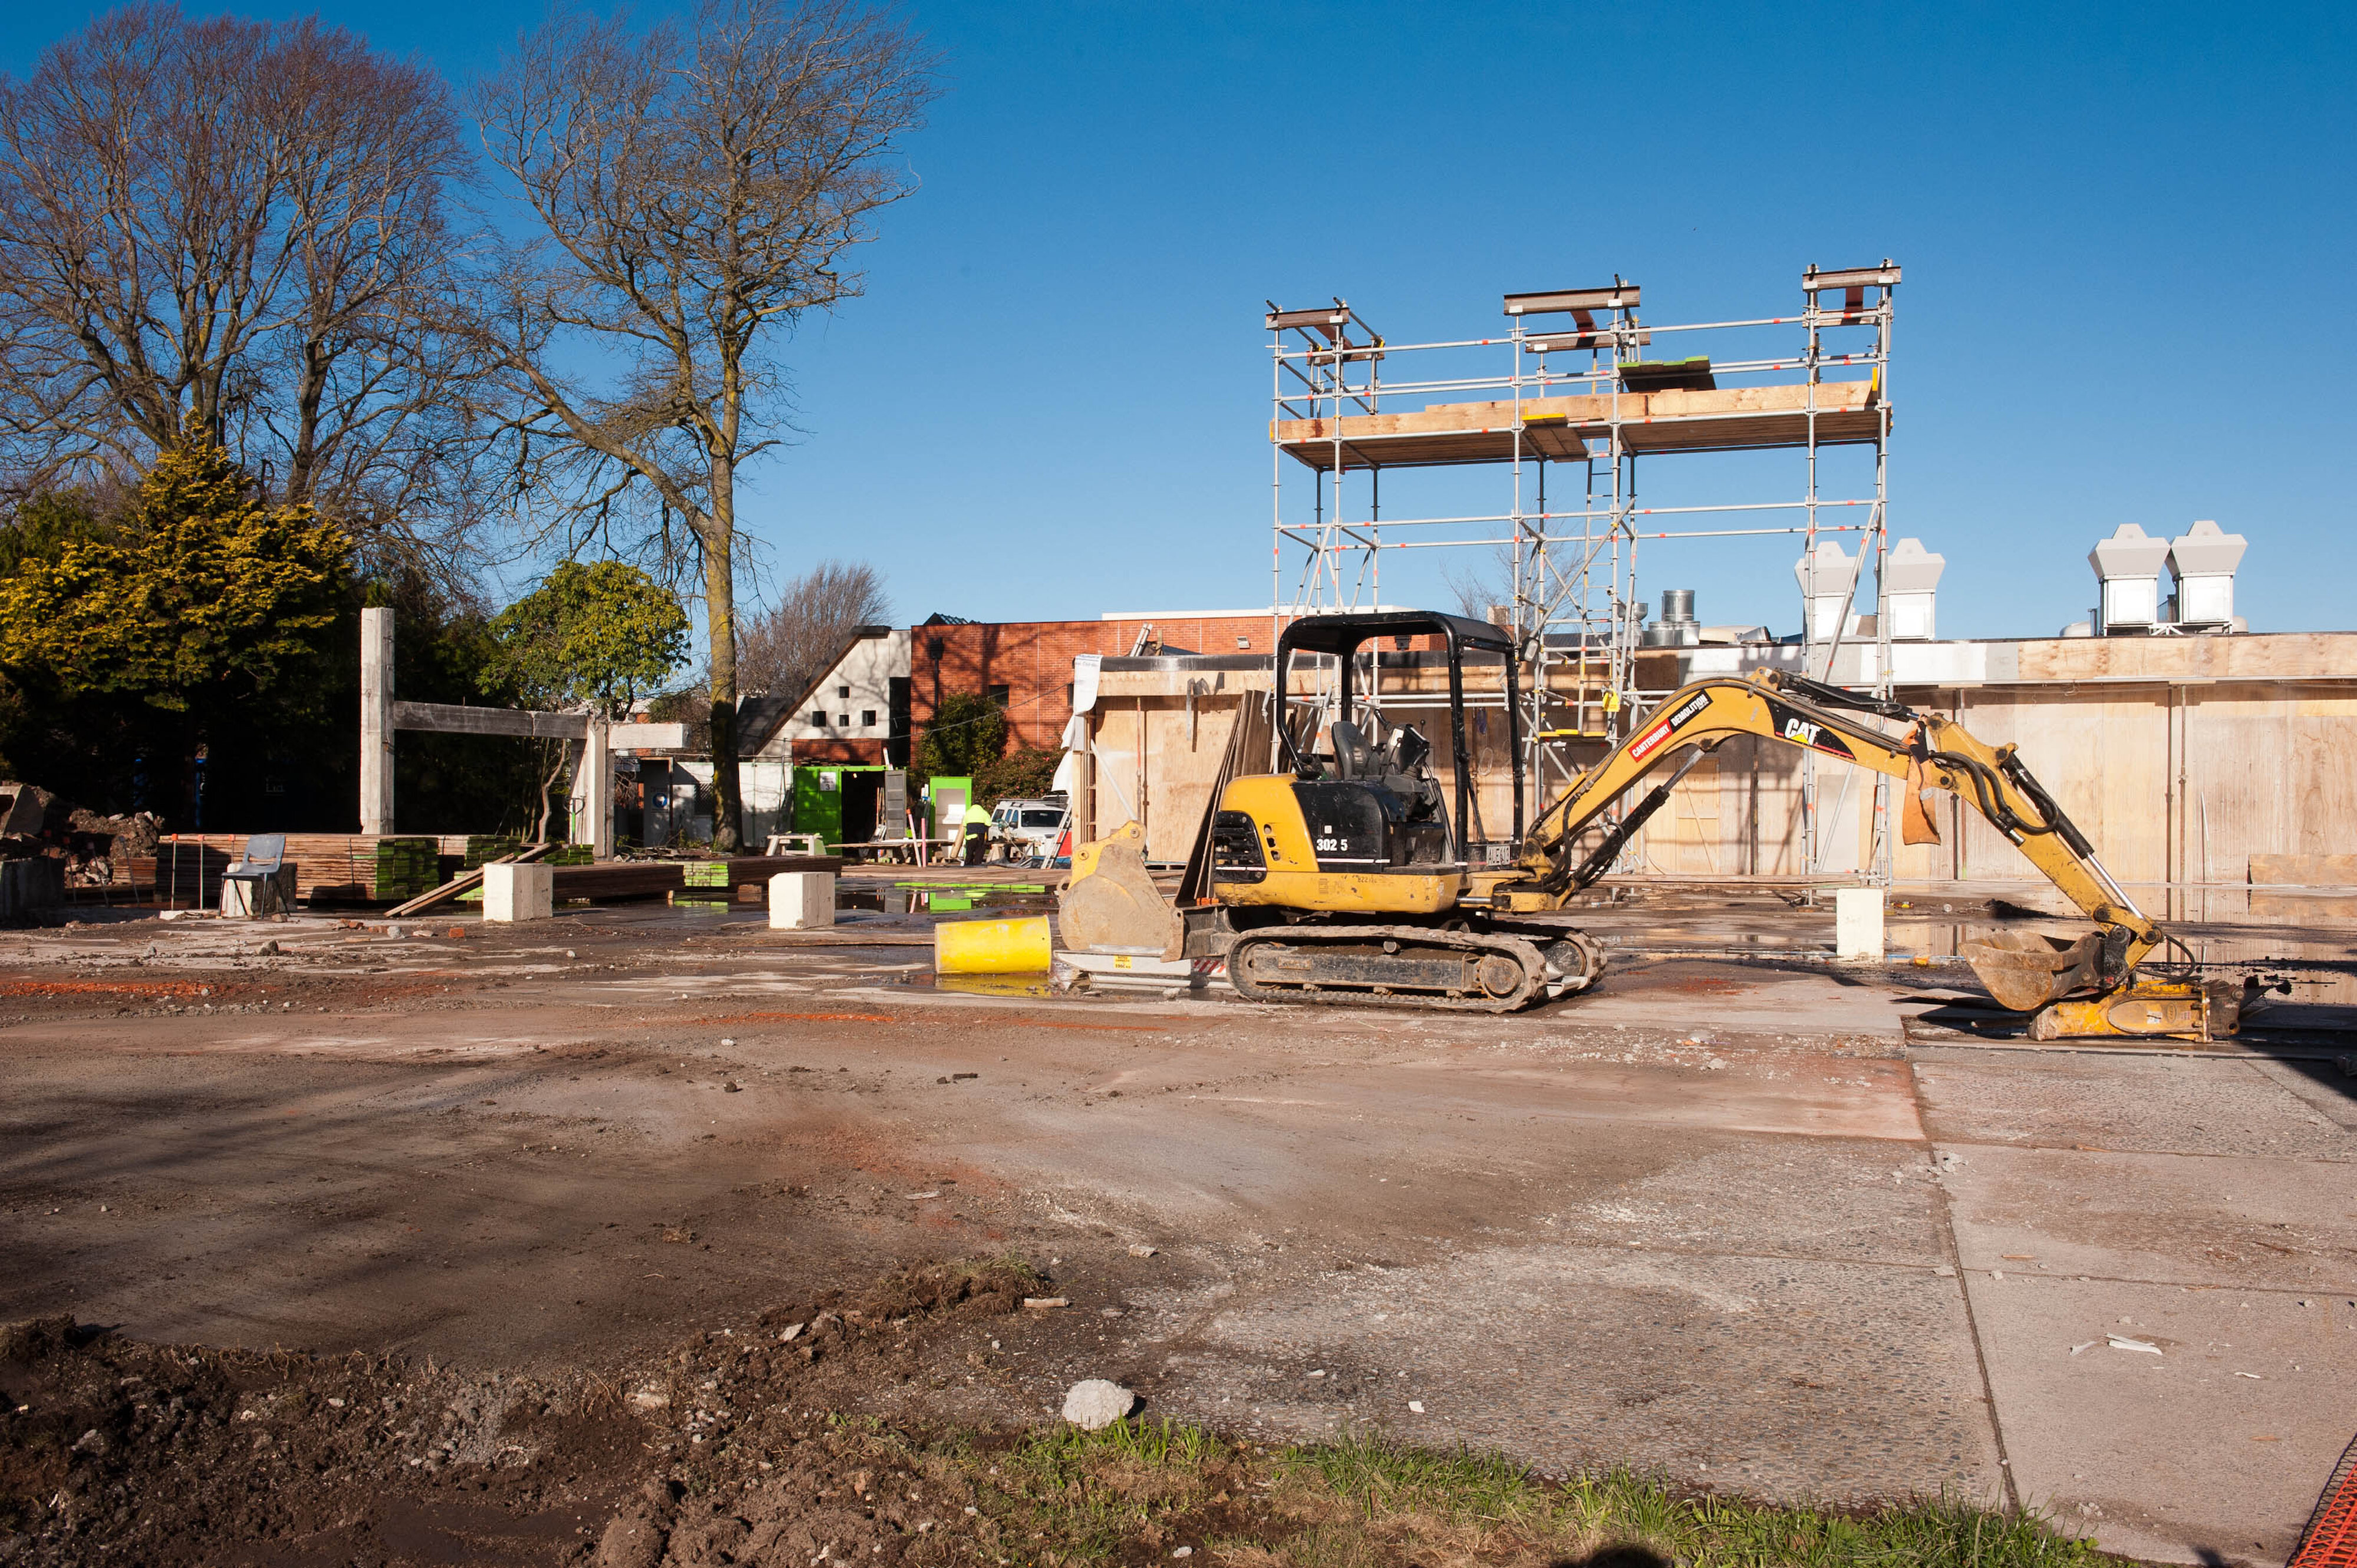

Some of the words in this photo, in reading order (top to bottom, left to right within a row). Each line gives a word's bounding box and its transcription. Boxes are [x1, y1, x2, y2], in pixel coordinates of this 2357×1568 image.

[1631, 724, 1670, 758] CANTERBURY
[1670, 694, 1708, 727] DEMOLITION
[1784, 718, 1823, 746] CAT
[1316, 839, 1337, 851] 302
